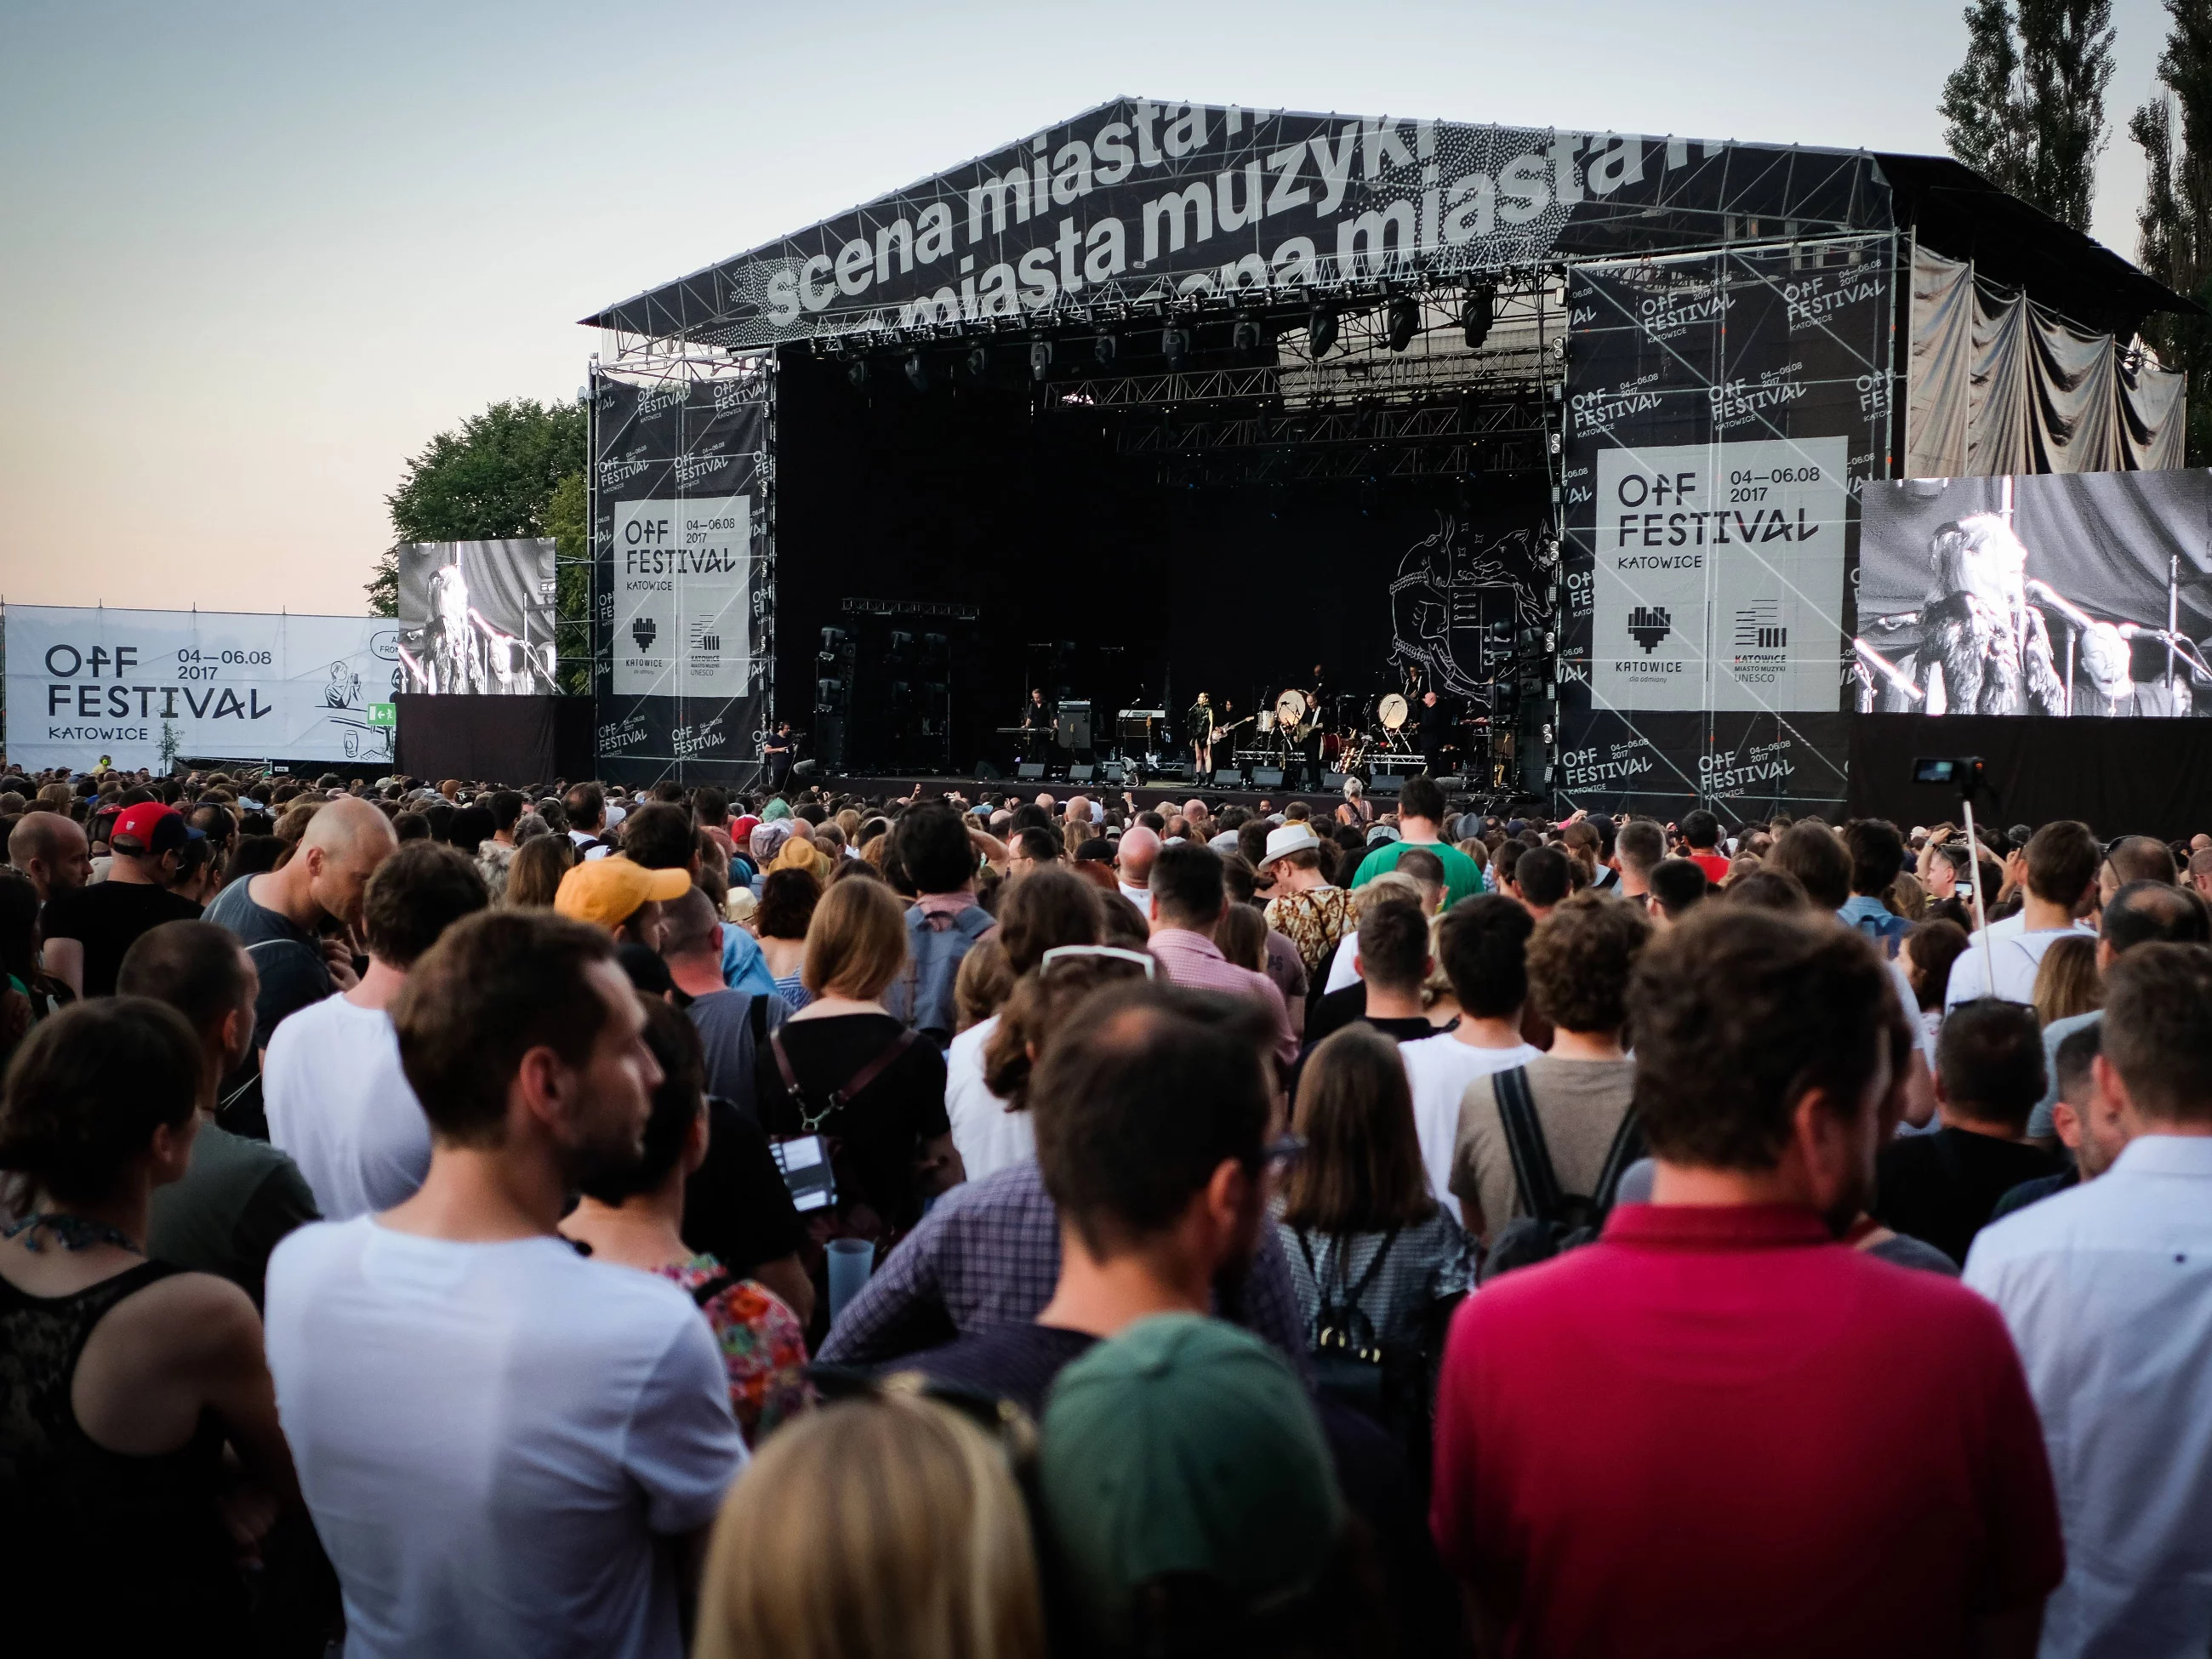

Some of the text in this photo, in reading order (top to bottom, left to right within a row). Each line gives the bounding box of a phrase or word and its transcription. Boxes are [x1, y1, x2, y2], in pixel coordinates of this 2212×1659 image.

[1337, 129, 1645, 277] miasta
[765, 98, 1209, 327] scena miasta
[1839, 274, 1859, 287] 2017
[1693, 288, 1711, 301] 2017
[1787, 278, 1886, 321] FESTIVAL
[1644, 294, 1736, 334] FESTIVAL
[1791, 313, 1833, 331] KATOWICE
[1647, 327, 1687, 344] KATOWICE
[1762, 376, 1780, 388] 2017
[715, 379, 767, 412] FESTIVAL
[1621, 386, 1638, 397] 2017
[638, 391, 689, 416] FESTIVAL
[1712, 382, 1807, 420] FESTIVAL
[1574, 391, 1662, 429] FESTIVAL
[1577, 422, 1615, 438] KATOWICE
[1715, 413, 1756, 430] KATOWICE
[601, 459, 649, 487] FESTIVAL
[676, 456, 728, 482] FESTIVAL
[1730, 487, 1768, 503] 2017
[1618, 508, 1819, 547] FESTIVAL
[687, 533, 707, 544] 2017
[627, 548, 735, 574] FESTIVAL
[1618, 556, 1702, 569] KATOWICE
[627, 581, 672, 590] KATOWICE
[625, 658, 663, 667] KATOWICE
[1616, 661, 1682, 672] KATOWICE
[1735, 655, 1786, 664] KATOWICE
[178, 666, 219, 680] 2017
[1735, 674, 1775, 683] UNESCO
[48, 685, 272, 719] FESTIVAL
[48, 727, 148, 740] KATOWICE
[599, 729, 647, 751] FESTIVAL
[674, 733, 726, 755] FESTIVAL
[1611, 750, 1628, 760] 2017
[1751, 752, 1769, 762] 2017
[1565, 756, 1653, 785] FESTIVAL
[1702, 760, 1795, 791] FESTIVAL
[1568, 783, 1606, 796] KATOWICE
[1705, 788, 1744, 801] KATOWICE
